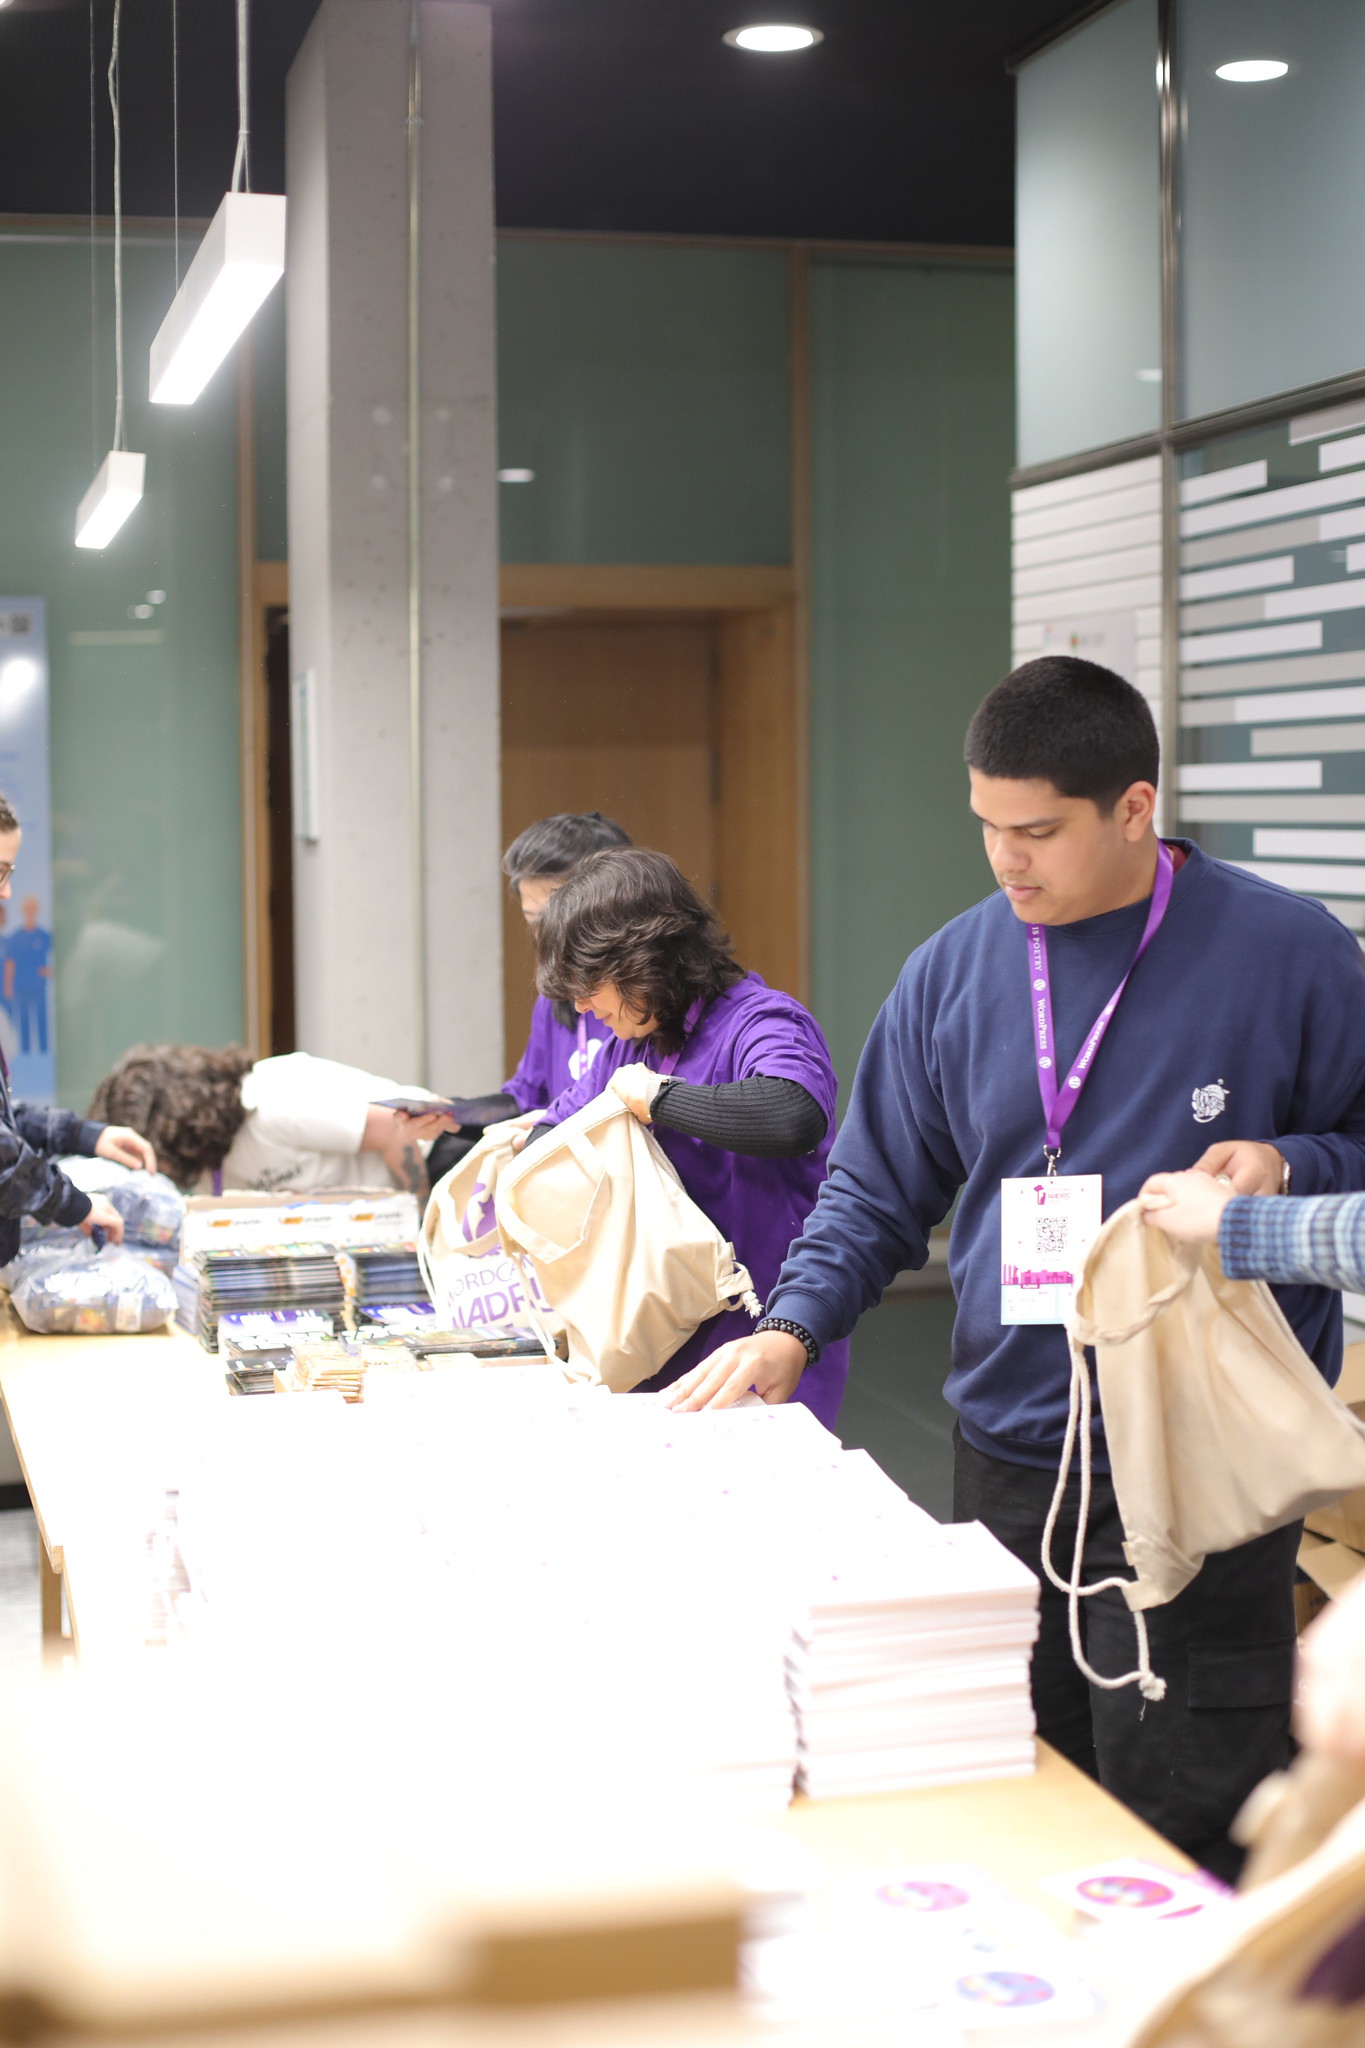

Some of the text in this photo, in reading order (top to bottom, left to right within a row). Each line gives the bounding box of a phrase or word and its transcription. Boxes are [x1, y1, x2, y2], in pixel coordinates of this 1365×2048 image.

[1032, 927, 1042, 971] IS POETRY
[451, 1277, 555, 1329] ADRI
